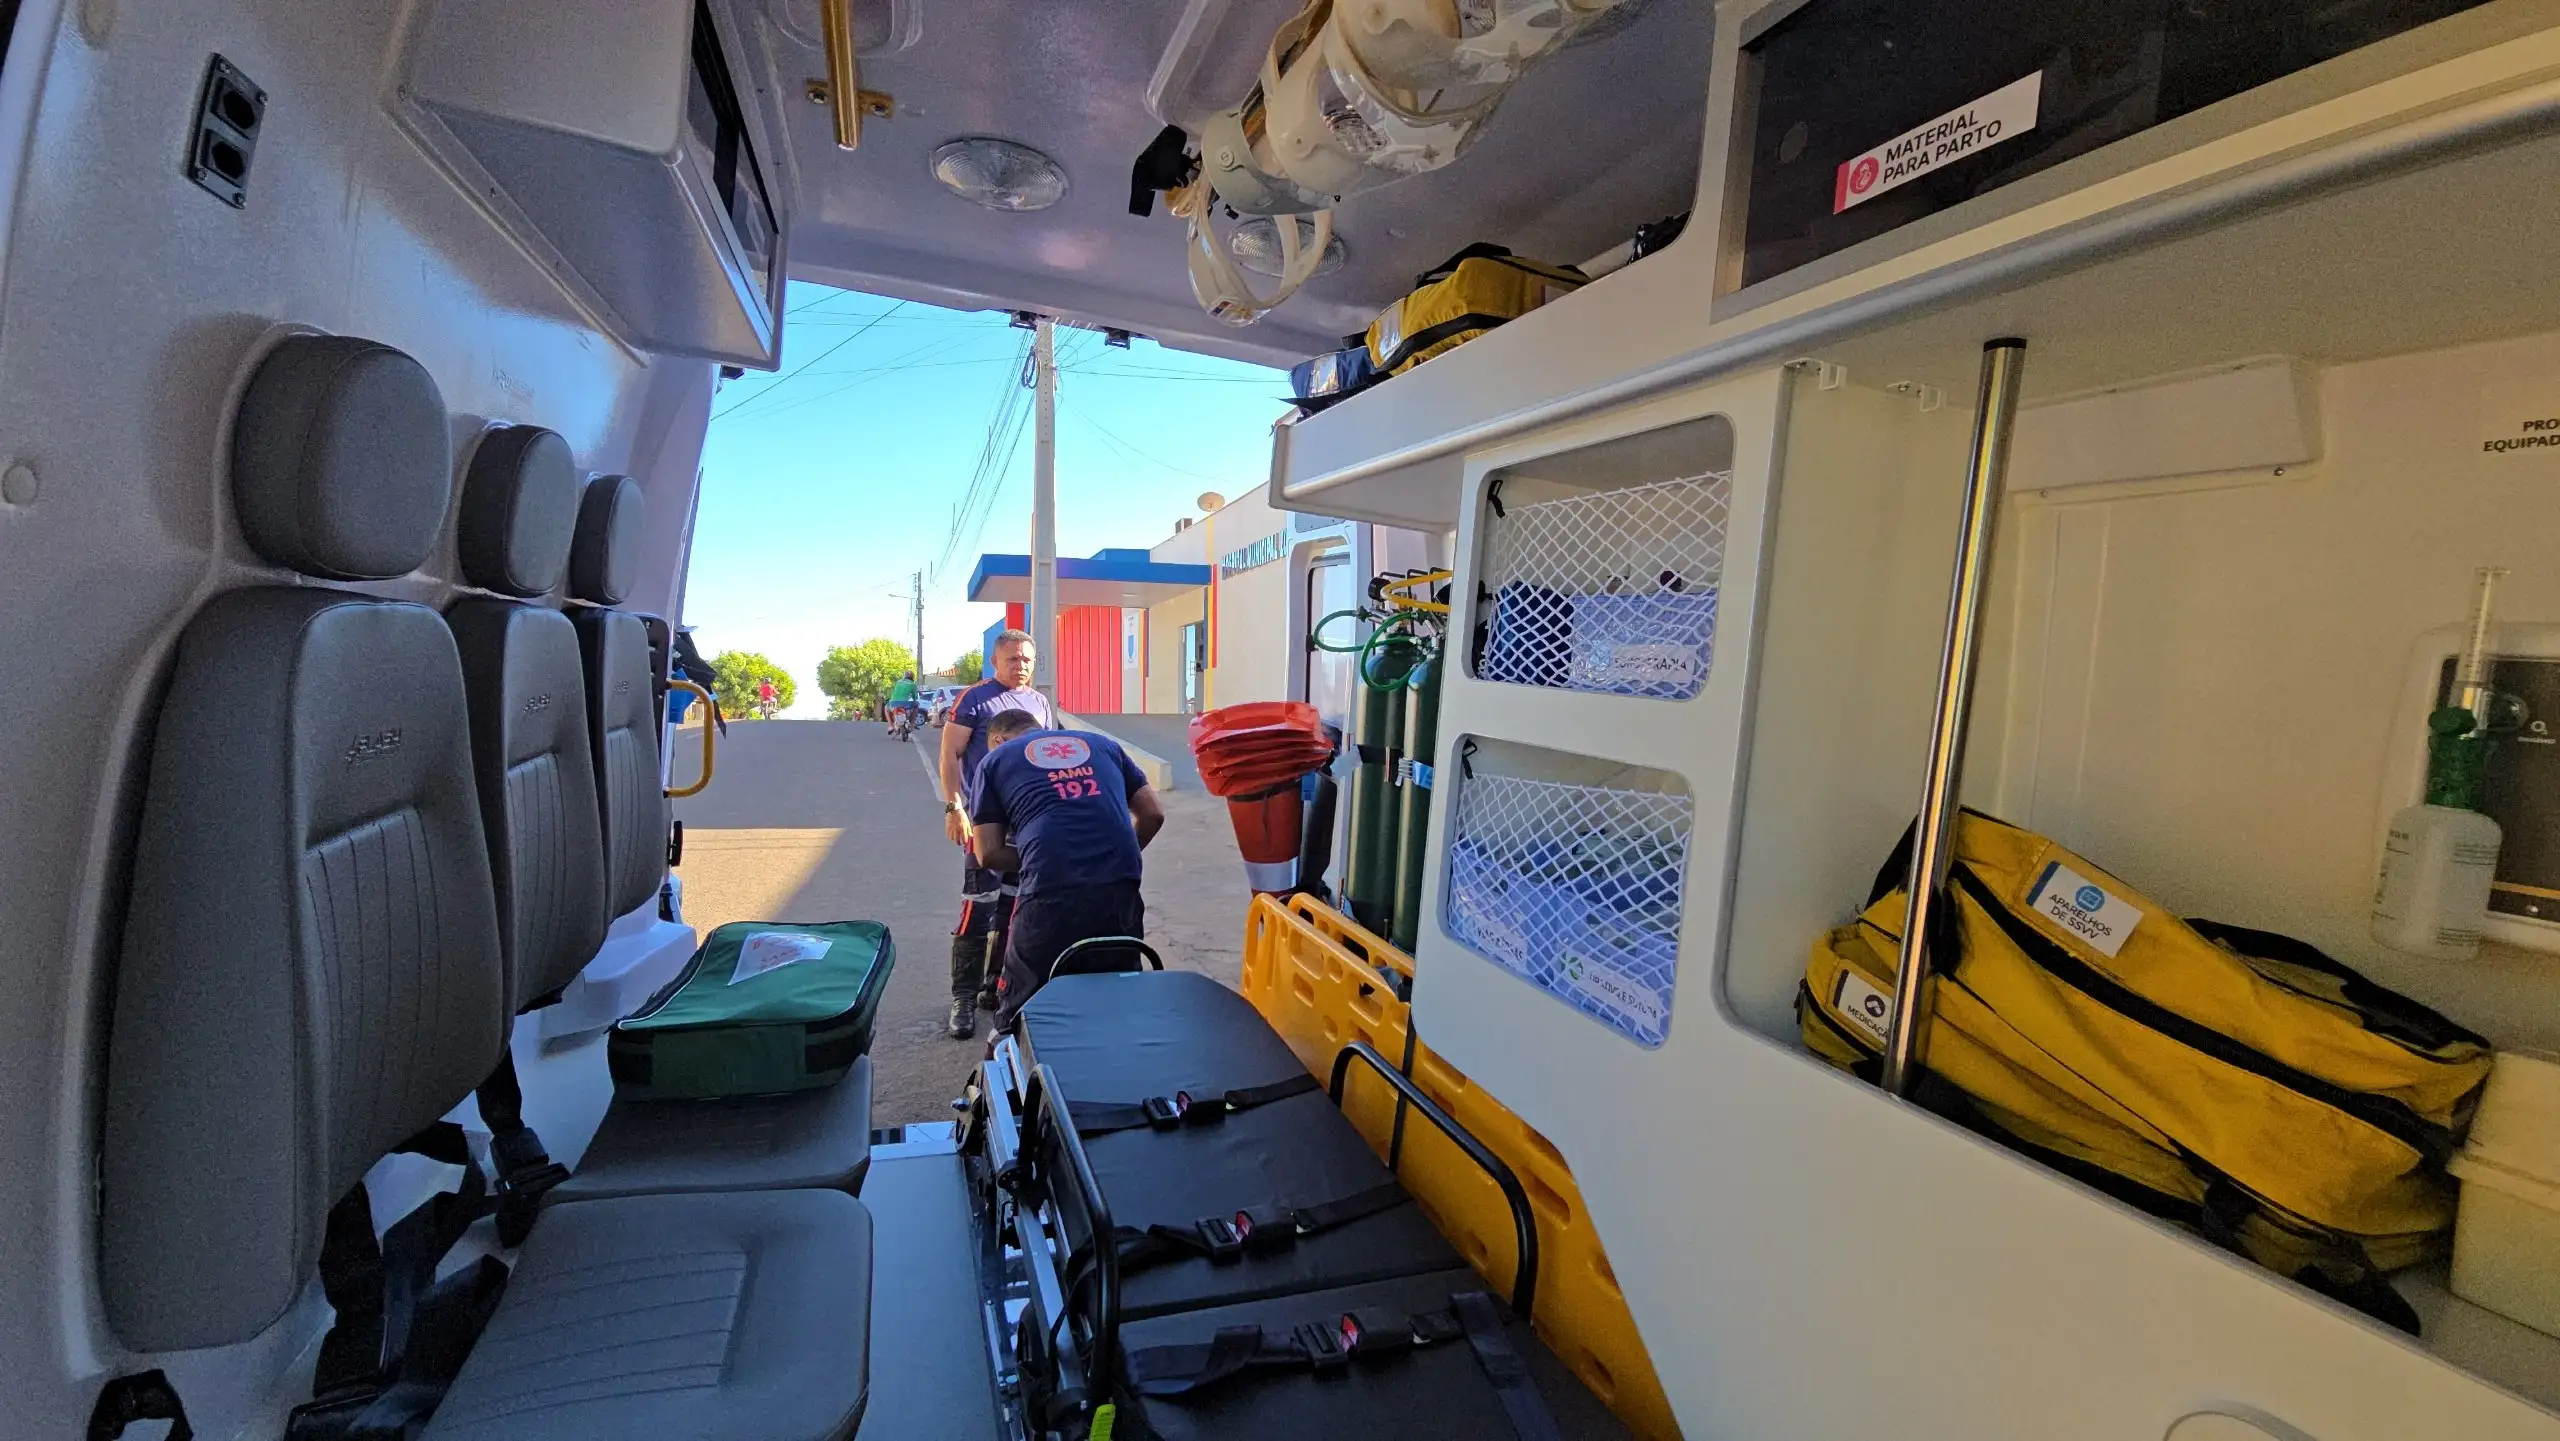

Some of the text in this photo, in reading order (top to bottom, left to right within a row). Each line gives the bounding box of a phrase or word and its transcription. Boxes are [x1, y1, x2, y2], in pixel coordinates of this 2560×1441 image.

[1883, 119, 2002, 184] PARA PARTO
[1885, 110, 1979, 163] MATERIAL
[1048, 766, 1094, 782] SAMU
[1053, 778, 1102, 800] 192
[2049, 894, 2112, 936] APARELHOS
[2051, 906, 2099, 939] DE SSVV
